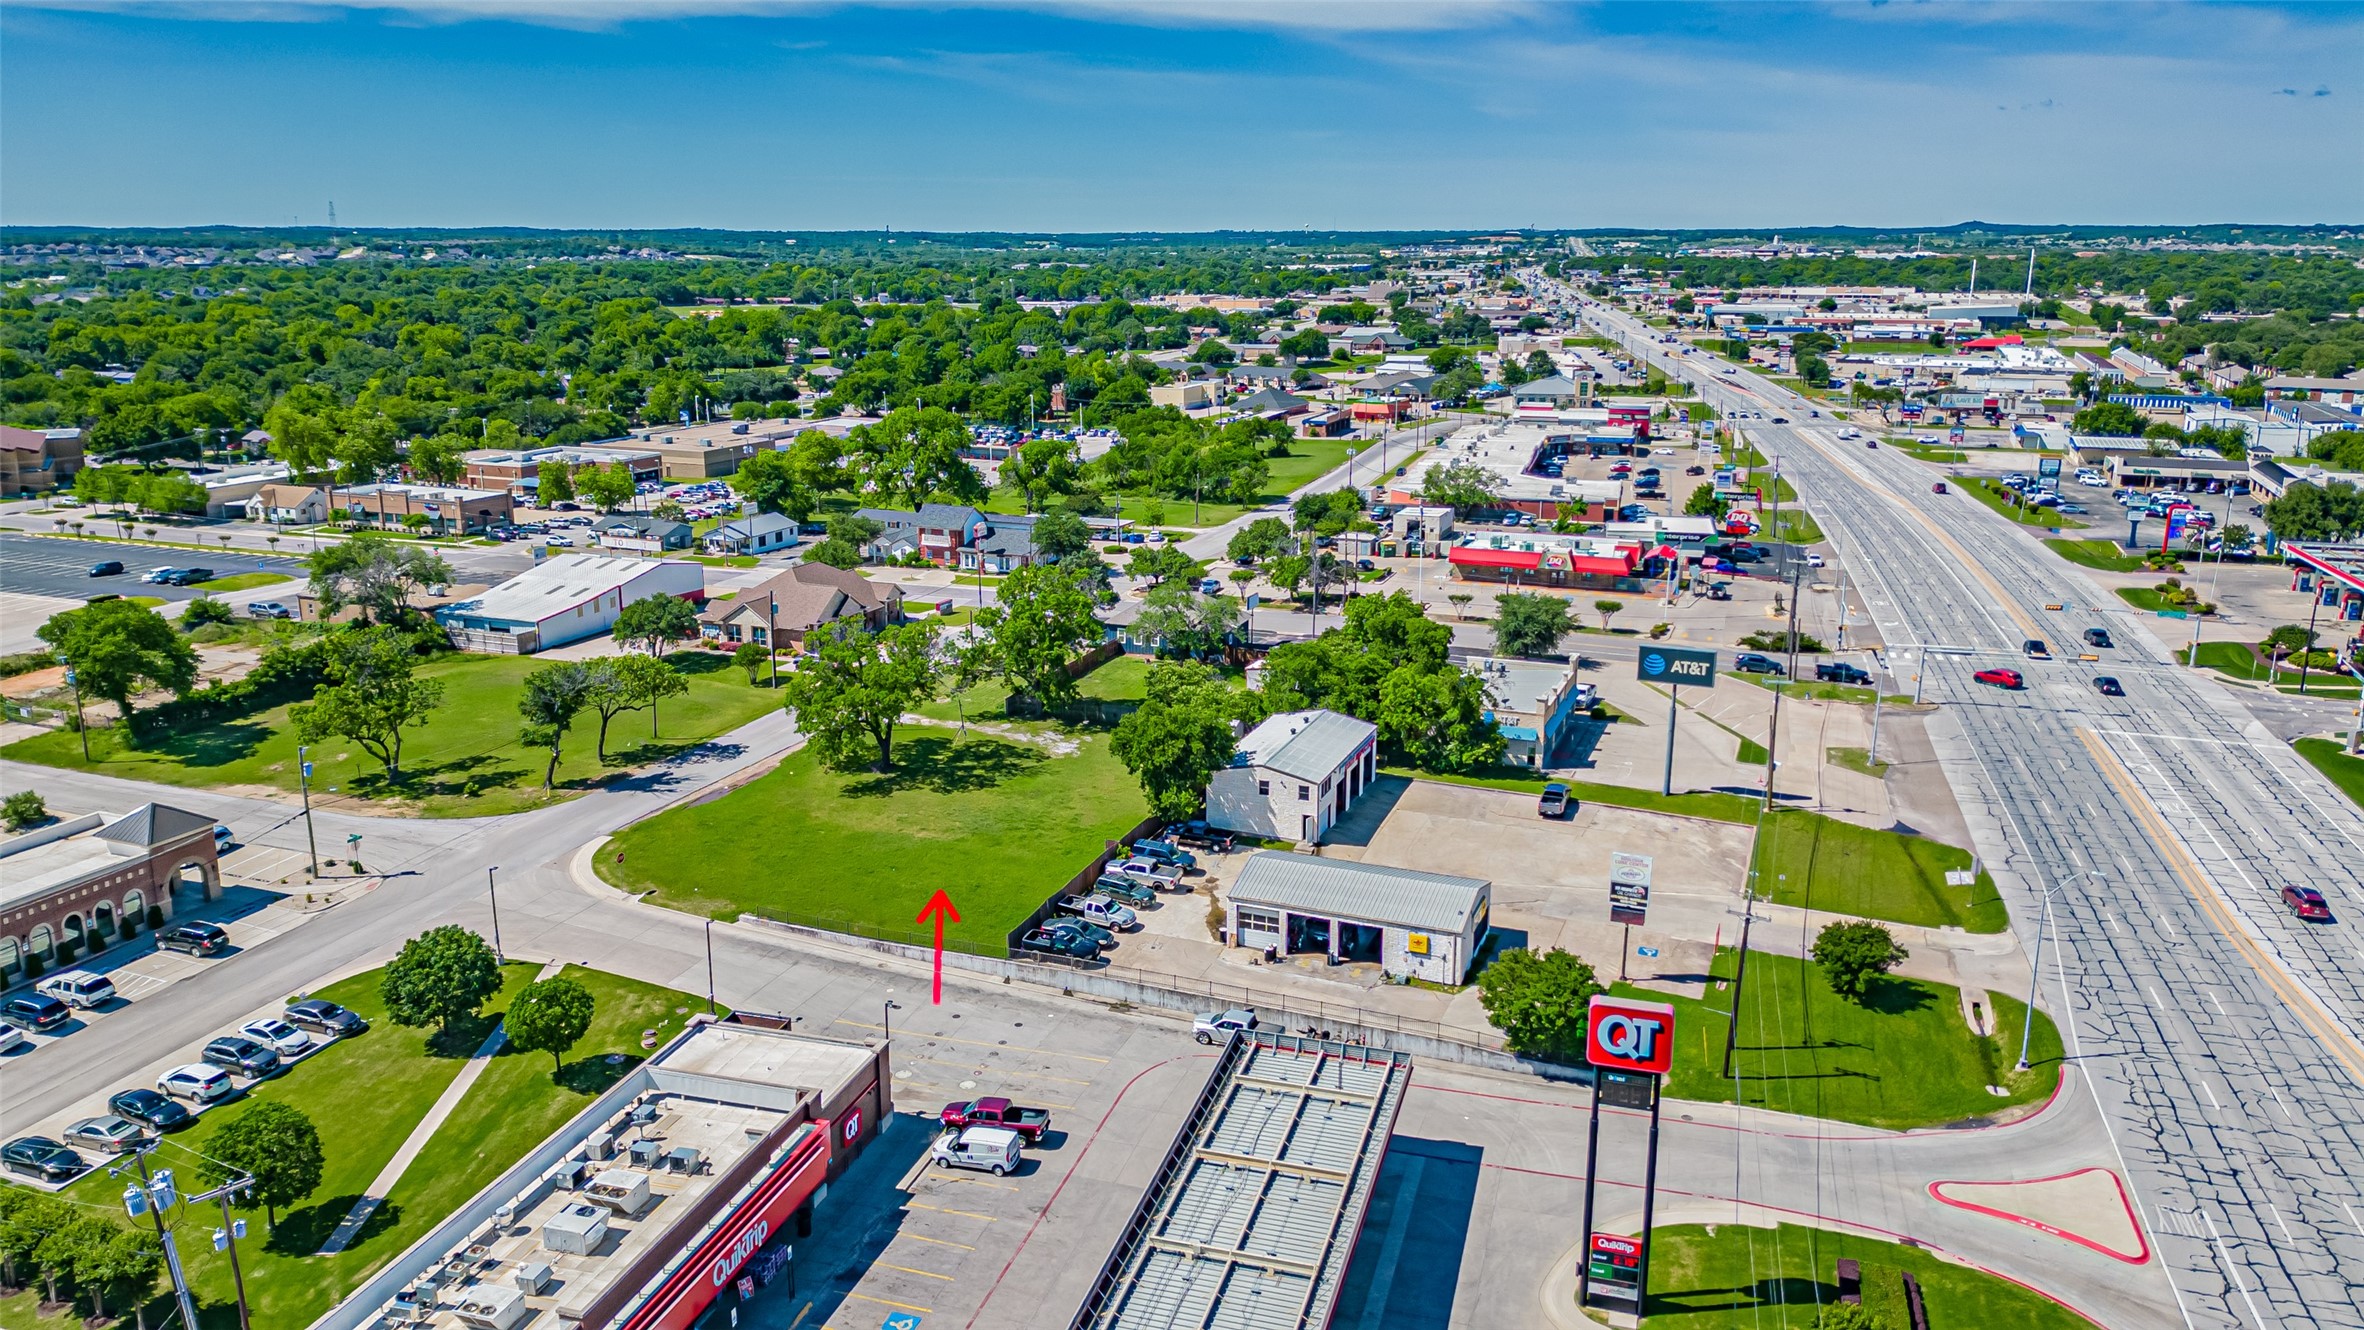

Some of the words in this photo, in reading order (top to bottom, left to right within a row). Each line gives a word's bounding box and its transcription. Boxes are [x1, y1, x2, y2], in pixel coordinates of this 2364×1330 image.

[1731, 512, 1749, 523] DQ
[1548, 557, 1563, 565] DQ
[1670, 660, 1711, 677] AT&T
[1597, 1014, 1661, 1061] QT
[845, 1112, 860, 1141] QT
[713, 1219, 769, 1287] QuikTrip
[1597, 1238, 1635, 1254] QuikTrip
